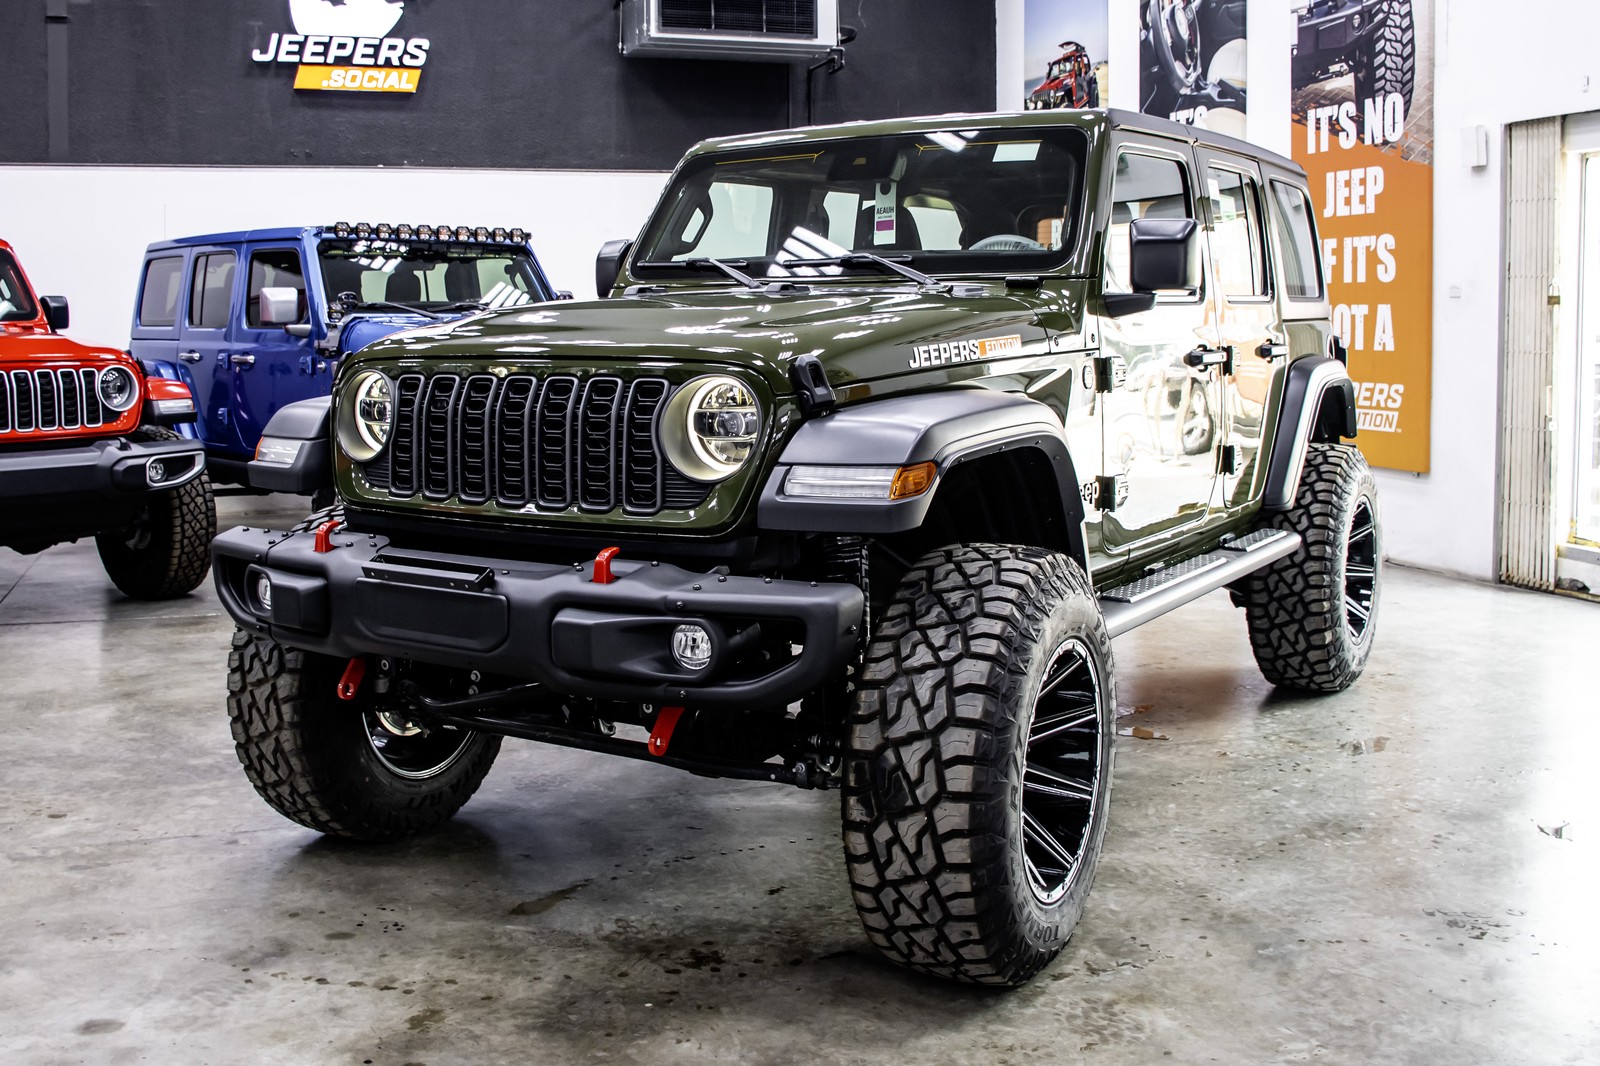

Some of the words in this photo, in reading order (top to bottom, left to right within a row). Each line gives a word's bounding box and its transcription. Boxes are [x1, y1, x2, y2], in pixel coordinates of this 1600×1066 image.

[252, 32, 430, 66] JEEPERS
[321, 69, 414, 89] .SOCIAL
[1306, 101, 1358, 155] IT'S
[1364, 92, 1405, 145] NO
[1323, 166, 1384, 218] JEEP
[1320, 238, 1337, 284] F
[1343, 233, 1397, 284] IT'S
[1330, 303, 1369, 351] OT
[1374, 304, 1395, 352] A
[908, 339, 979, 369] JEEPERS
[985, 337, 1021, 357] EDITION
[1352, 381, 1405, 409] PERS
[1357, 412, 1395, 429] ITION
[1079, 481, 1100, 504] eep
